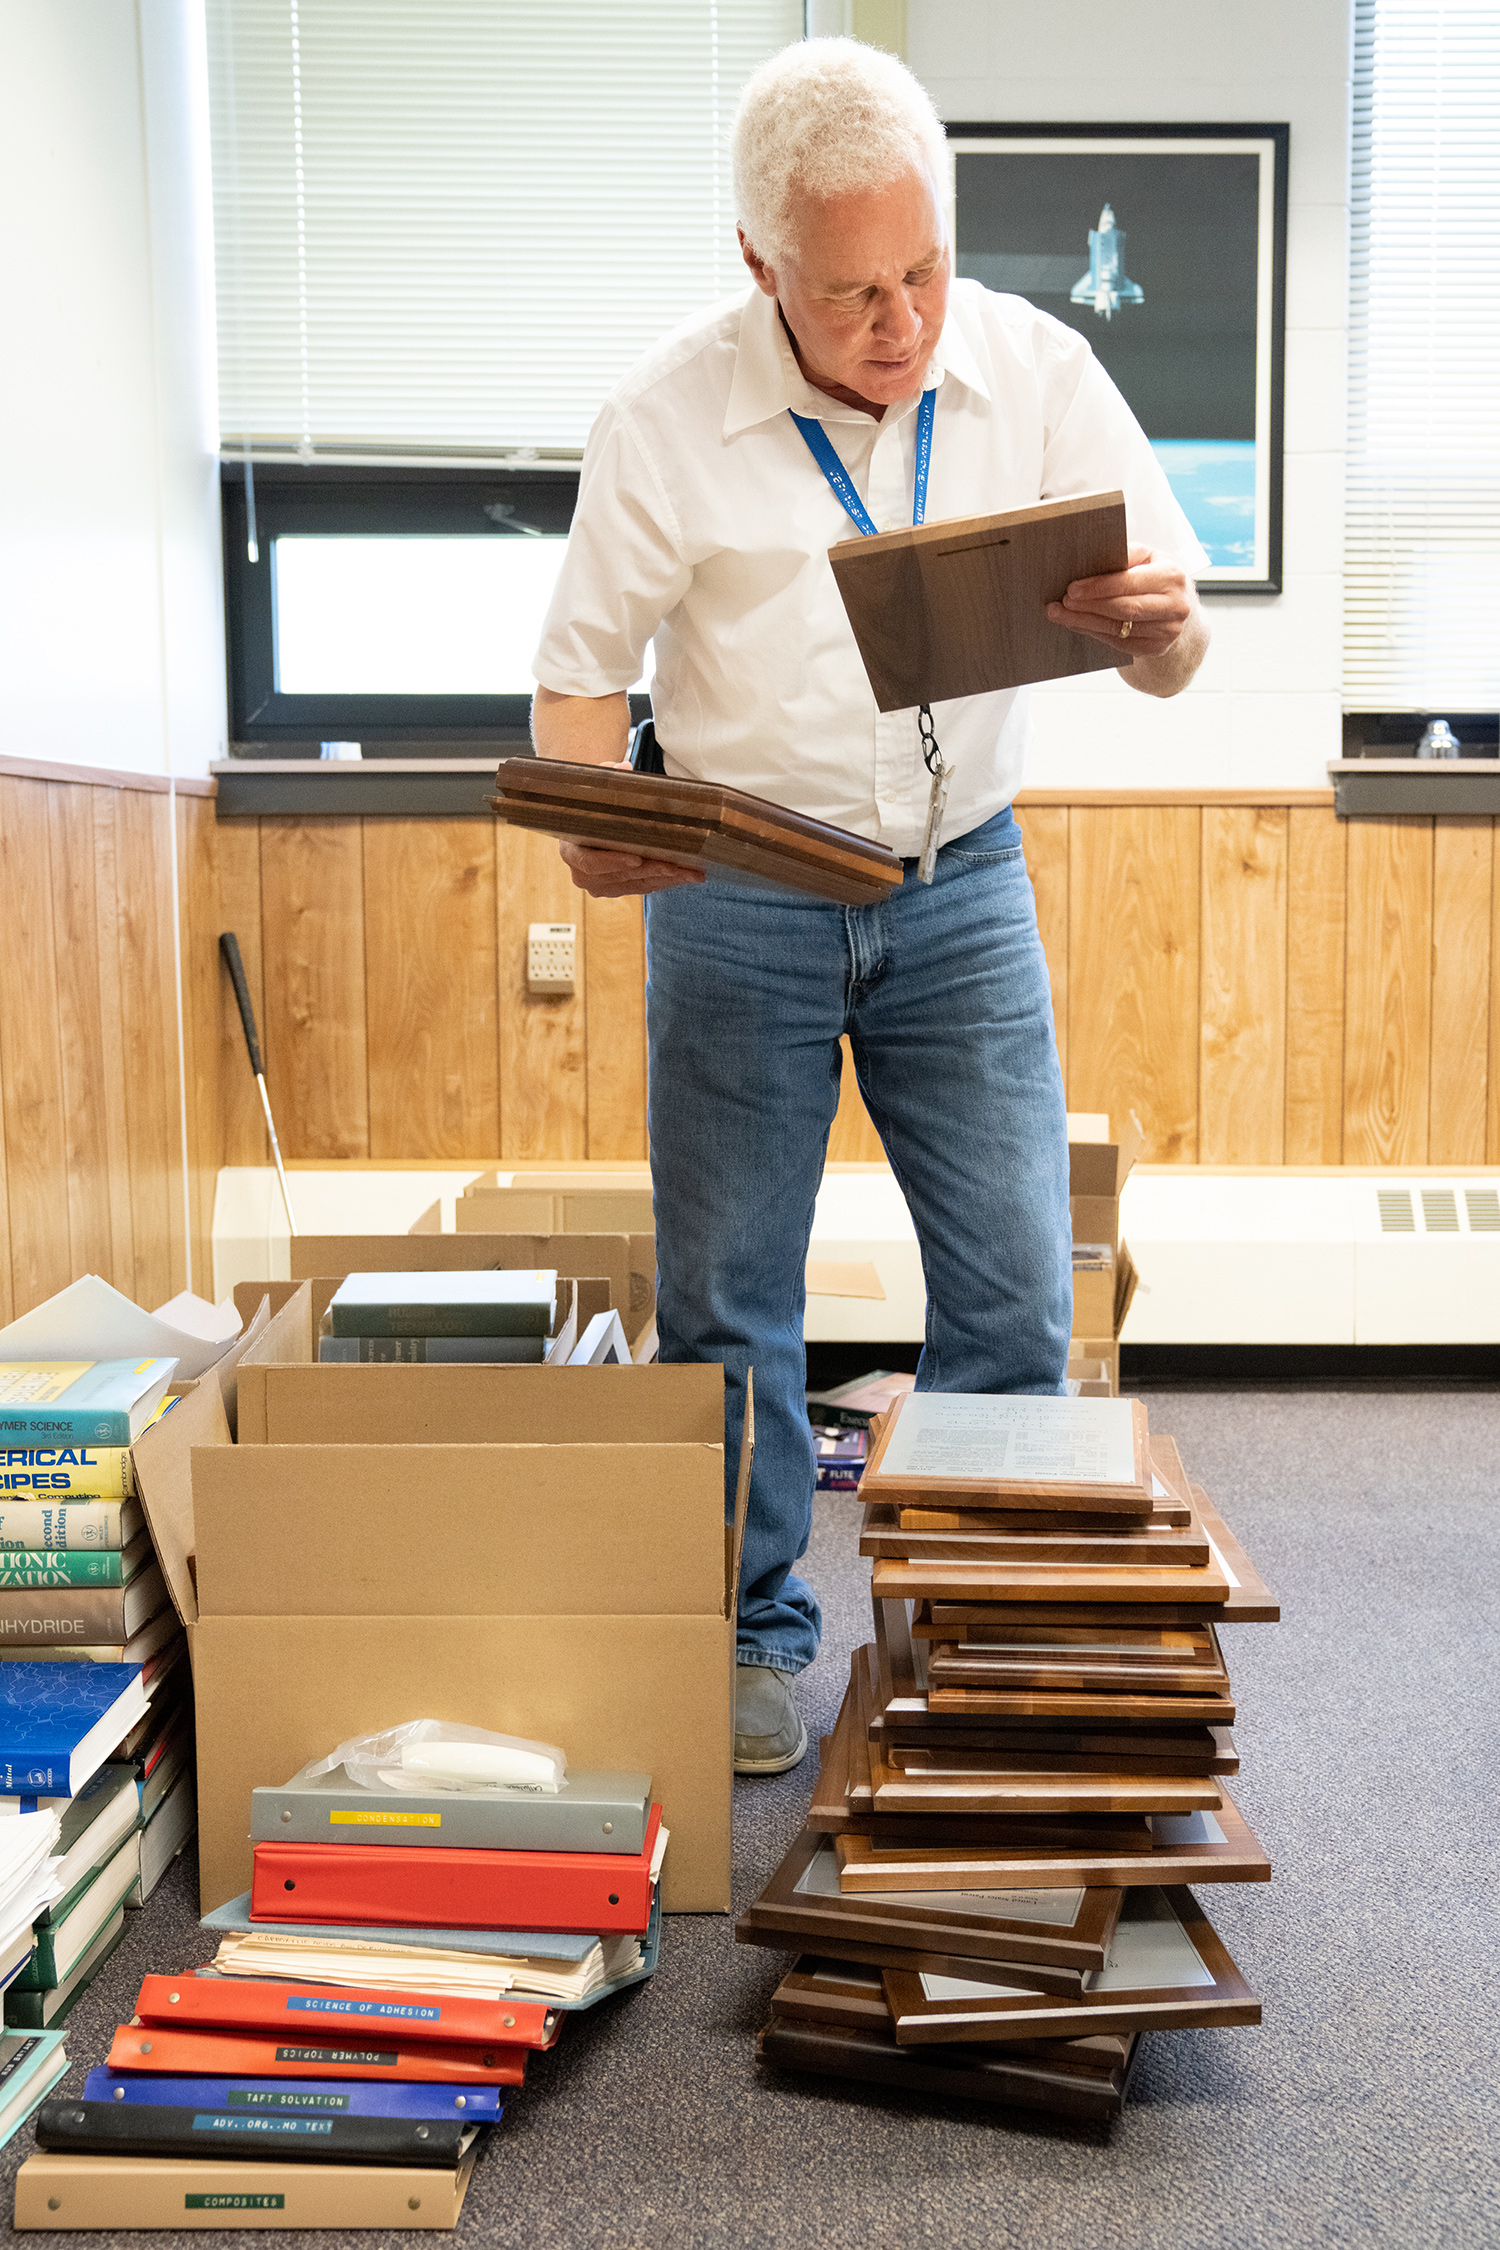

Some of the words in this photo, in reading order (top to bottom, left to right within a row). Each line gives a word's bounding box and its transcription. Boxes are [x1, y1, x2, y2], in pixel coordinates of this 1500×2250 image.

[30, 1421, 73, 1432] SCIENCE
[53, 1432, 74, 1440] Edition
[121, 1451, 129, 1496] Cambridge
[42, 1509, 53, 1549] econd
[55, 1508, 68, 1550] dition
[5, 1763, 13, 1788] Mittal
[356, 1814, 435, 1825] CONDENSATION
[305, 2000, 351, 2011] SCIENCE
[359, 2004, 373, 2012] OF
[379, 2006, 434, 2018] ADHESION
[282, 2049, 323, 2059] TOPICS
[331, 2052, 380, 2062] POLYMER
[247, 2093, 273, 2103] TAFT
[280, 2095, 344, 2106] SOLVATION
[305, 2122, 333, 2131] TEXT
[204, 2197, 277, 2207] COMPOSITES
